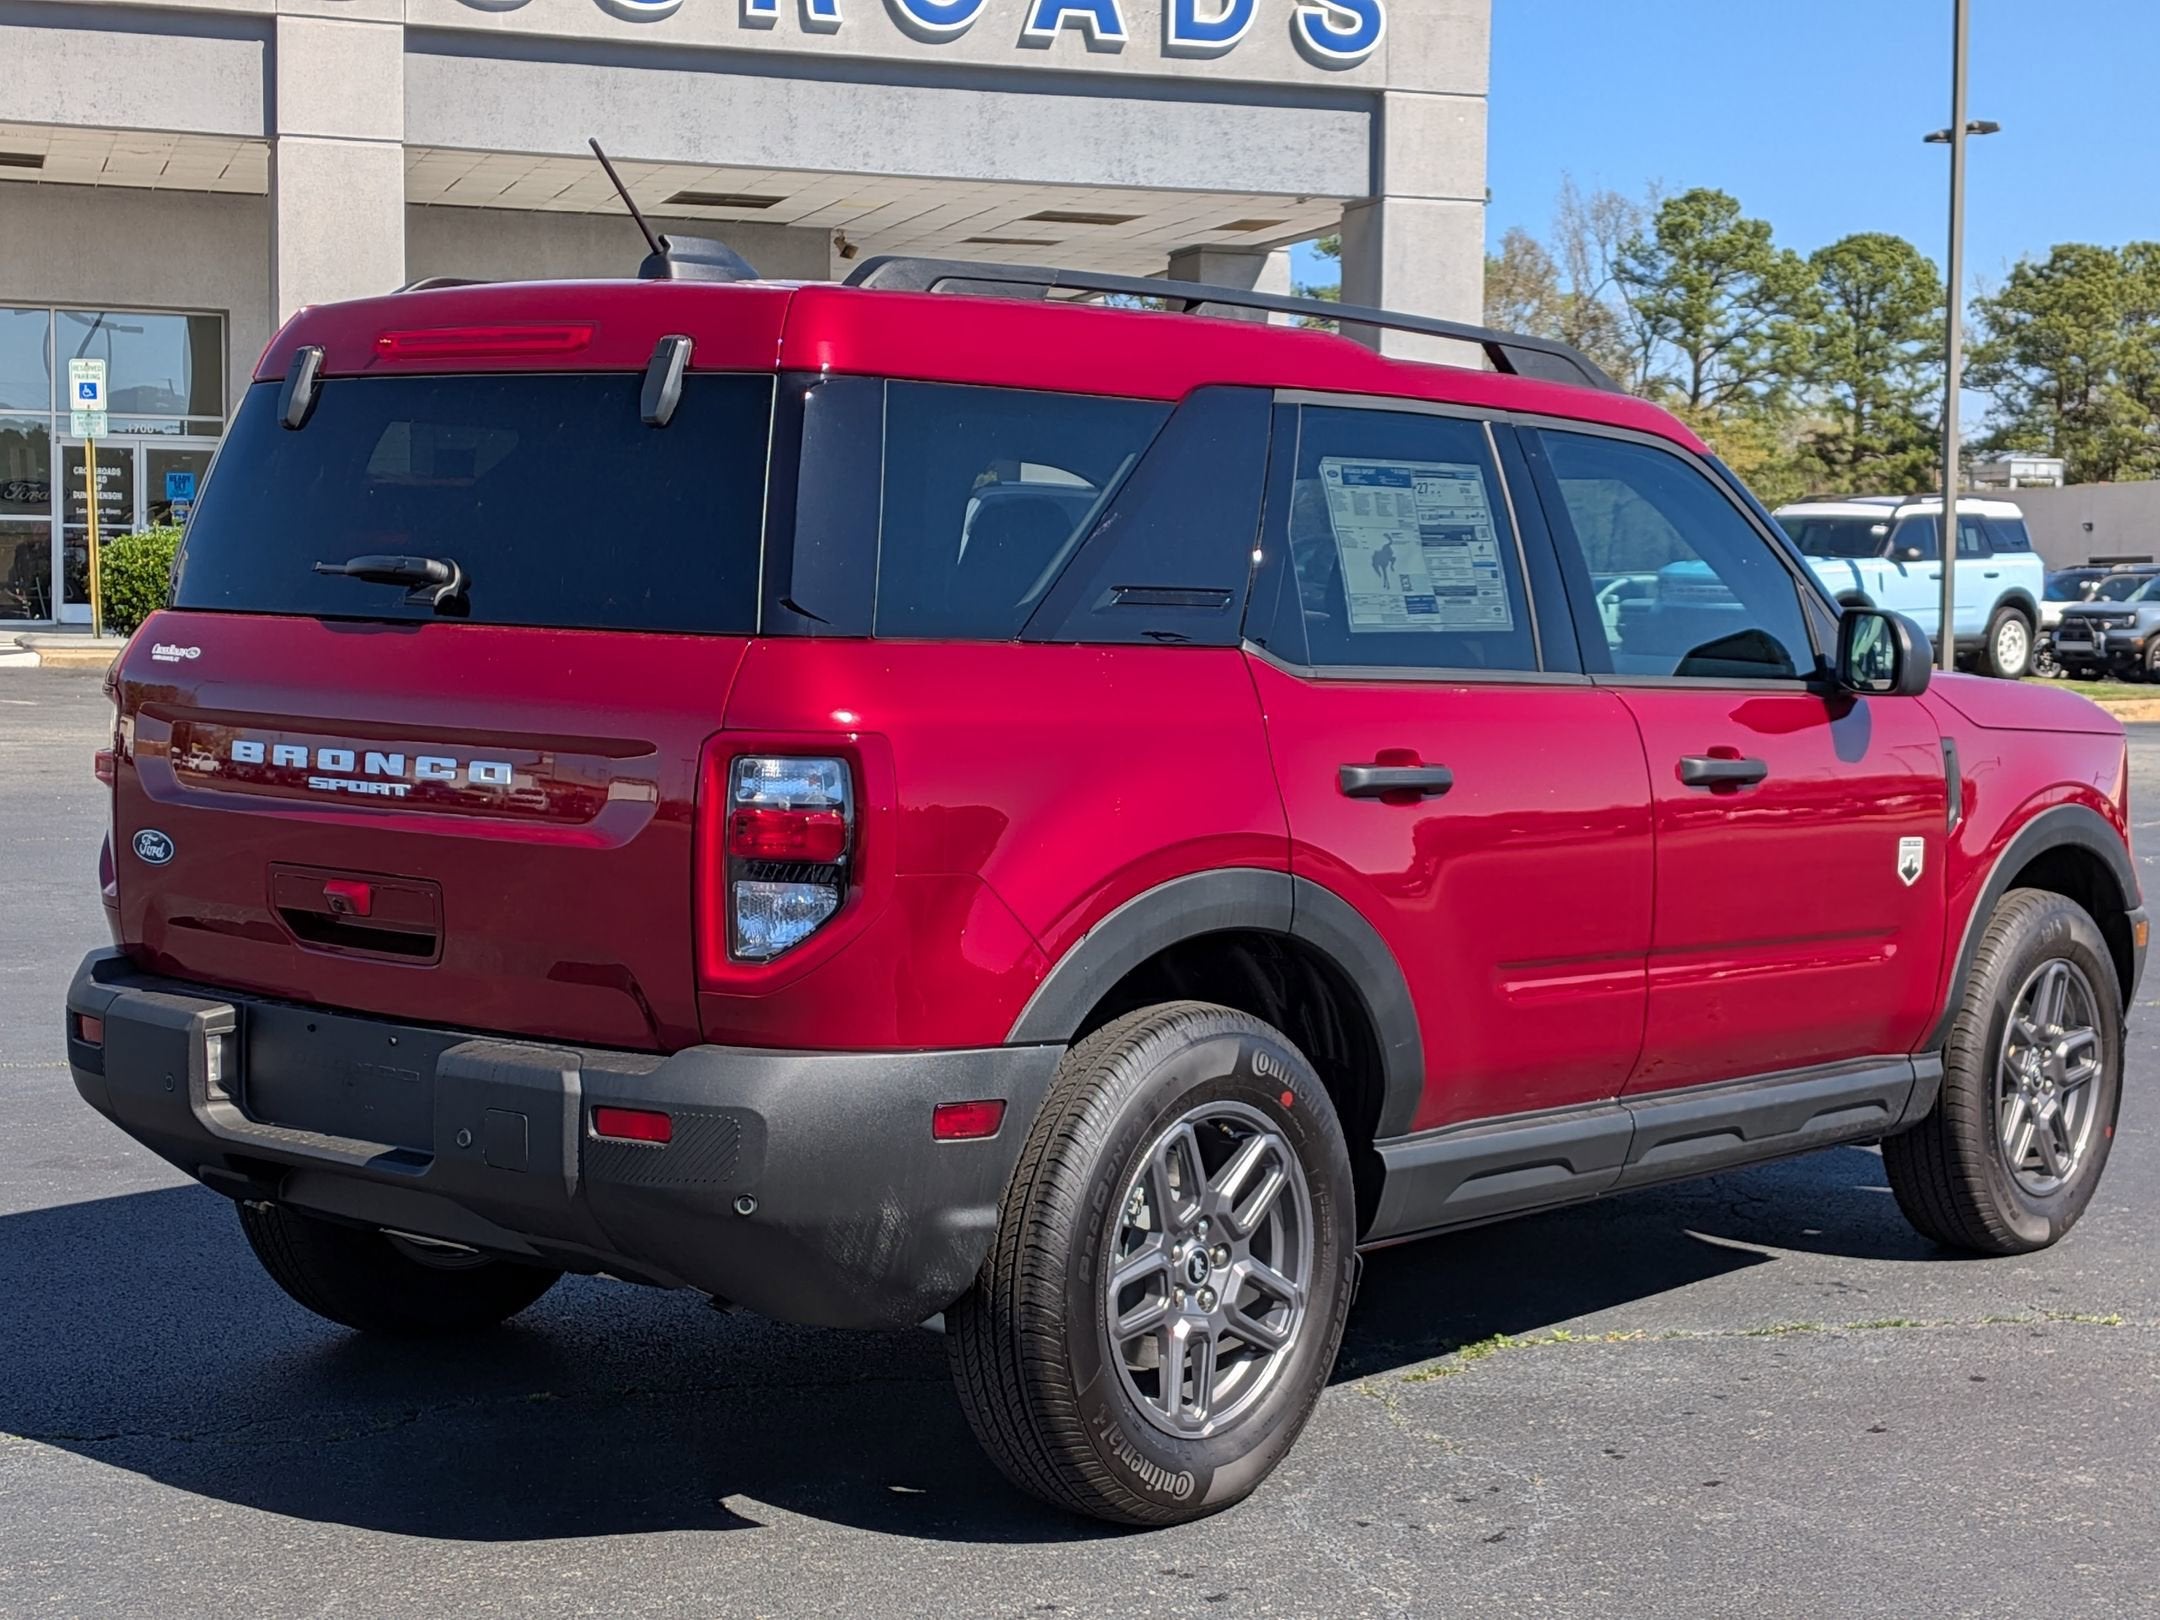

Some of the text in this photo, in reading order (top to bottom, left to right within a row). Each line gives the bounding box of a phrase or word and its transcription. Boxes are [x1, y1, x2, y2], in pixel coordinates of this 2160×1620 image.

[231, 739, 513, 785] BRONCO
[307, 776, 412, 797] SPORT
[139, 833, 166, 858] Ford
[1098, 1420, 1196, 1502] Continental
